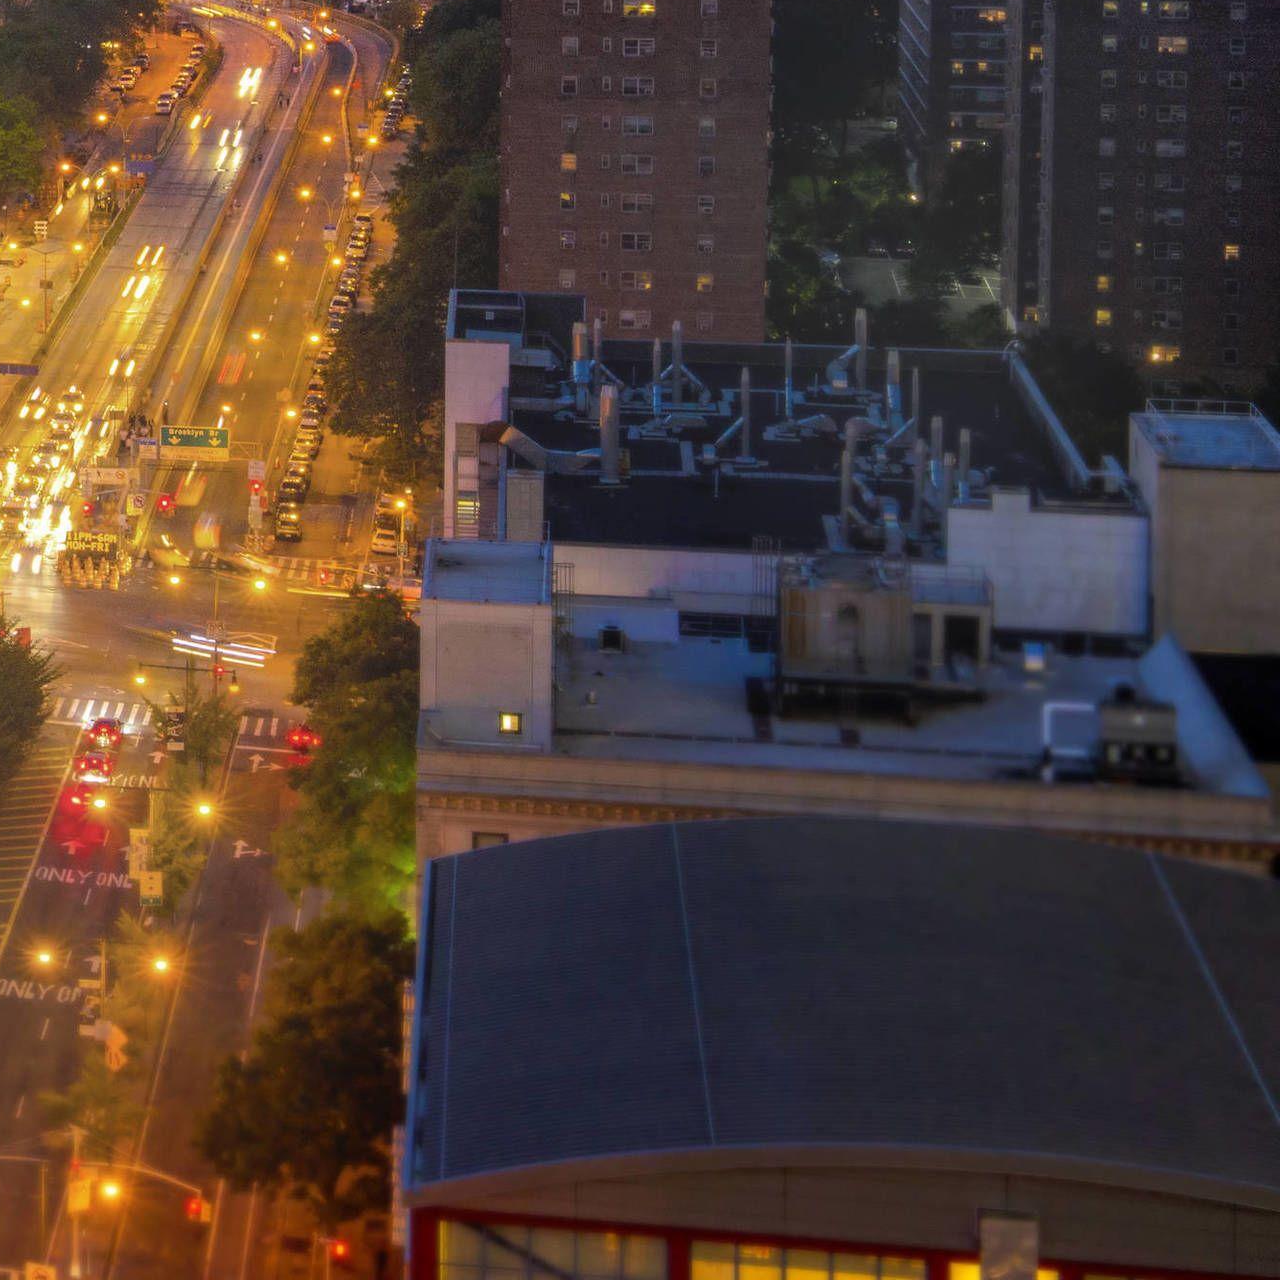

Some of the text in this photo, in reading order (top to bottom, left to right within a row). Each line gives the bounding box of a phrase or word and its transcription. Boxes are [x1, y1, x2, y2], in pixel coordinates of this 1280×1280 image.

[169, 428, 204, 437] Brooklyn
[67, 541, 110, 552] MON-FRI
[35, 867, 133, 889] ONLY ONL
